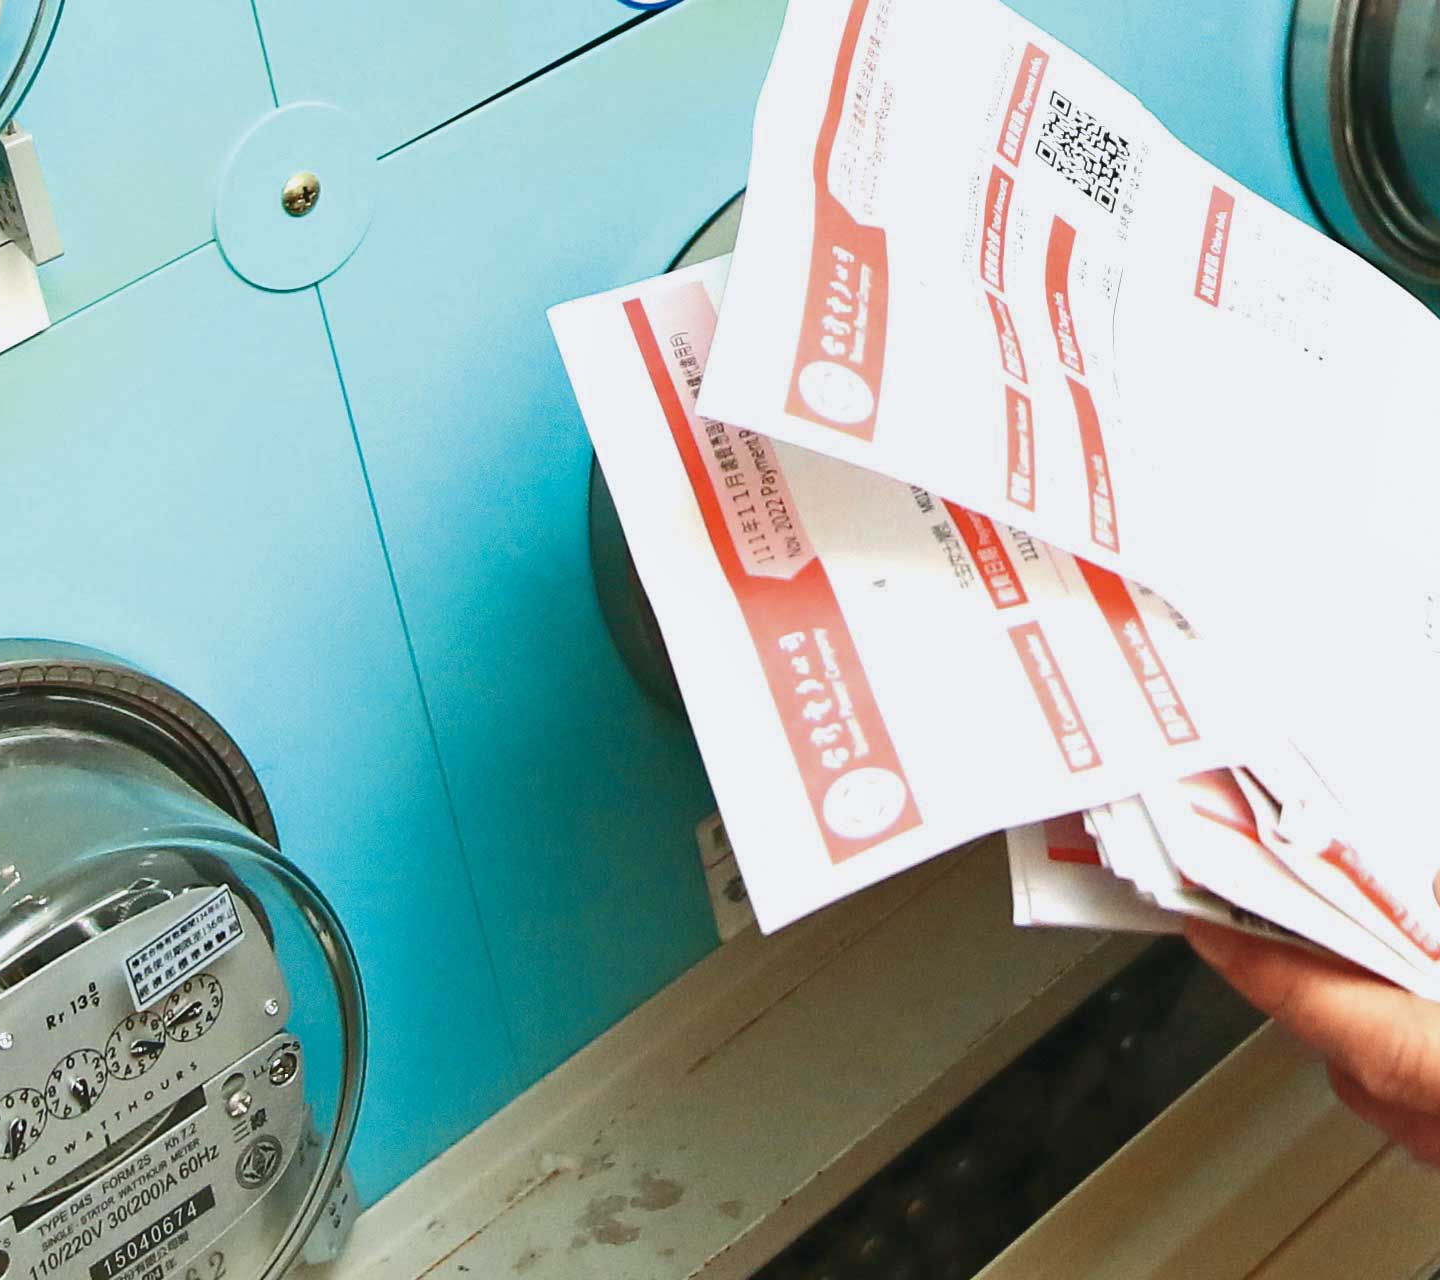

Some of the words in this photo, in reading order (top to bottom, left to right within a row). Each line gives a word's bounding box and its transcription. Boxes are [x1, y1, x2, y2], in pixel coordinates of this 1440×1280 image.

[1208, 228, 1224, 253] Other
[738, 433, 781, 499] Payment
[762, 495, 792, 536] 2022
[46, 1012, 66, 1031] Rr
[71, 995, 89, 1016] 13
[5, 1061, 199, 1194] KILOWATTHOURS
[38, 1212, 68, 1236] TYPE
[70, 1196, 93, 1218] D4S
[102, 1170, 136, 1194] FORM
[137, 1155, 152, 1176] 2S
[164, 1137, 180, 1153] Kh
[181, 1122, 197, 1143] 7.2
[119, 1162, 168, 1201] WATTHOUR
[170, 1137, 200, 1164] METER
[29, 1218, 104, 1280] 110/220V
[107, 1176, 179, 1228] 30(200)A
[178, 1144, 220, 1181] 60Hz
[103, 1199, 198, 1278] 15040674
